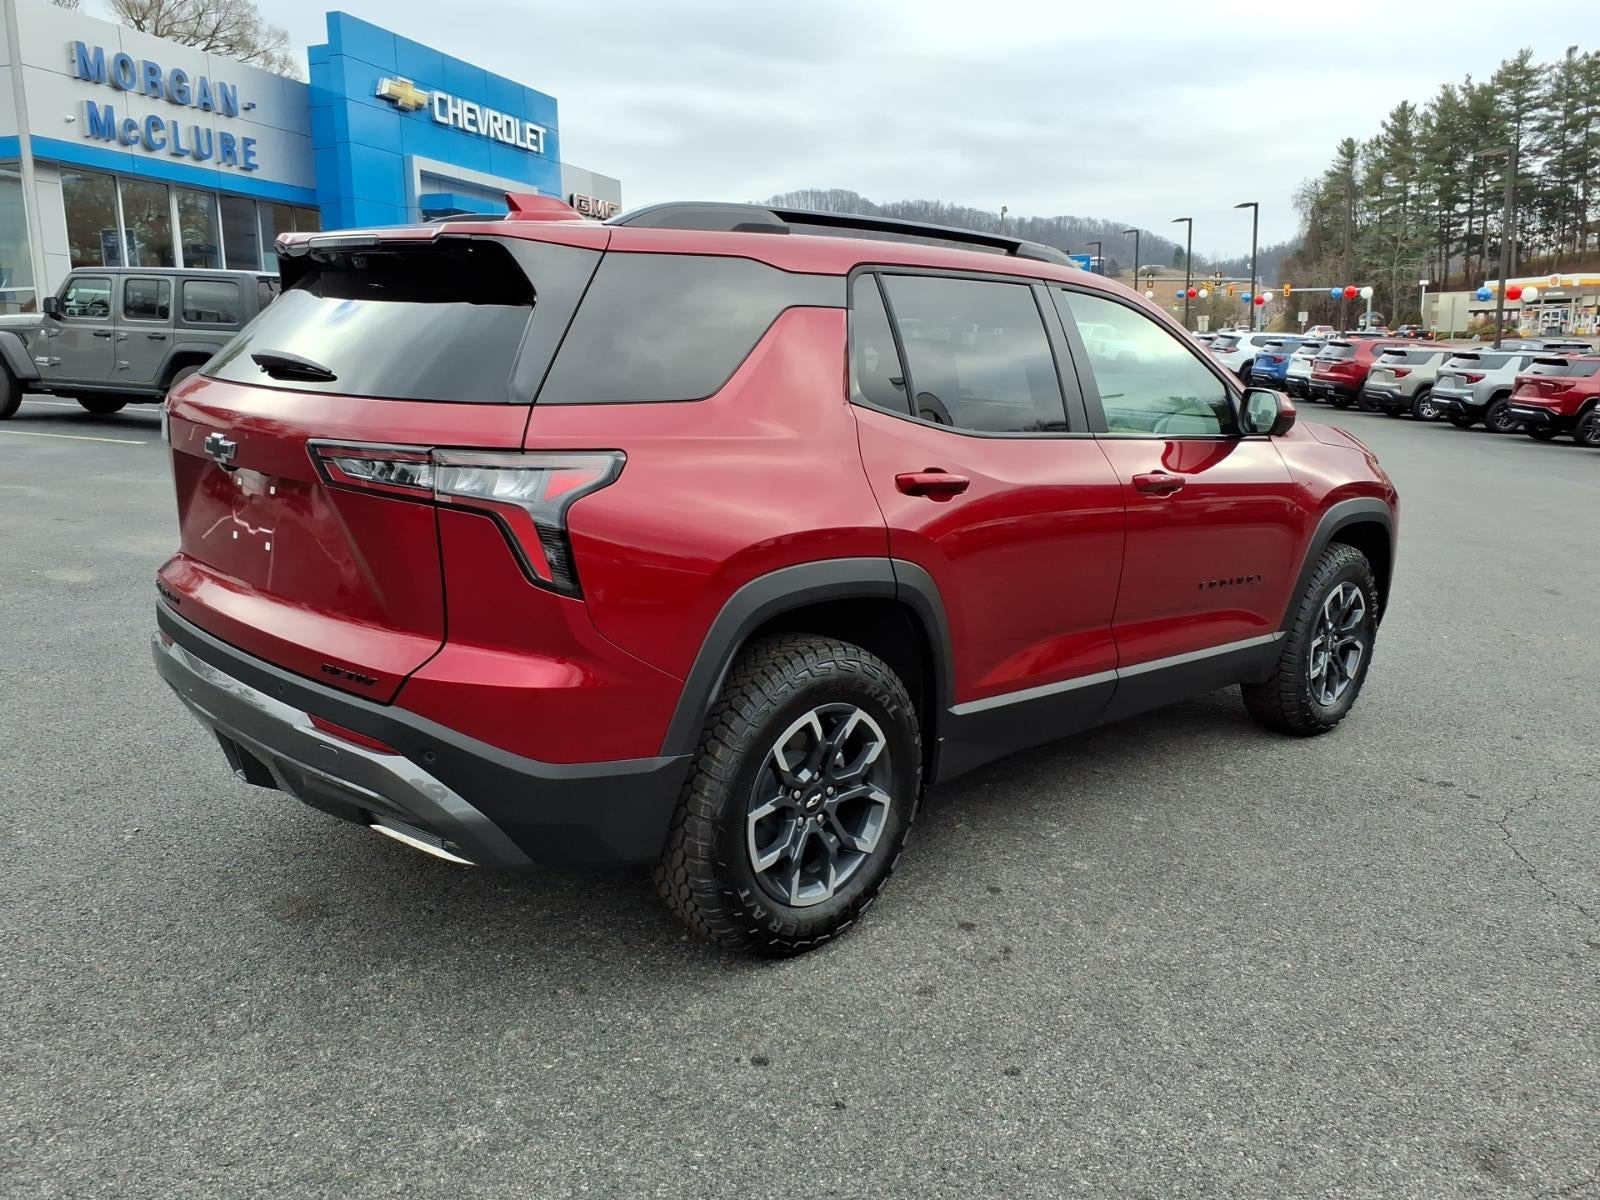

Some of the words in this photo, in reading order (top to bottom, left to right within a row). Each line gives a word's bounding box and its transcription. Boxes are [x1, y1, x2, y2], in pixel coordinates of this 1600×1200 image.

[70, 40, 256, 117] MORGAN-
[81, 99, 259, 171] McCLURE
[431, 90, 547, 154] CHEVROLET
[571, 192, 620, 219] GMC
